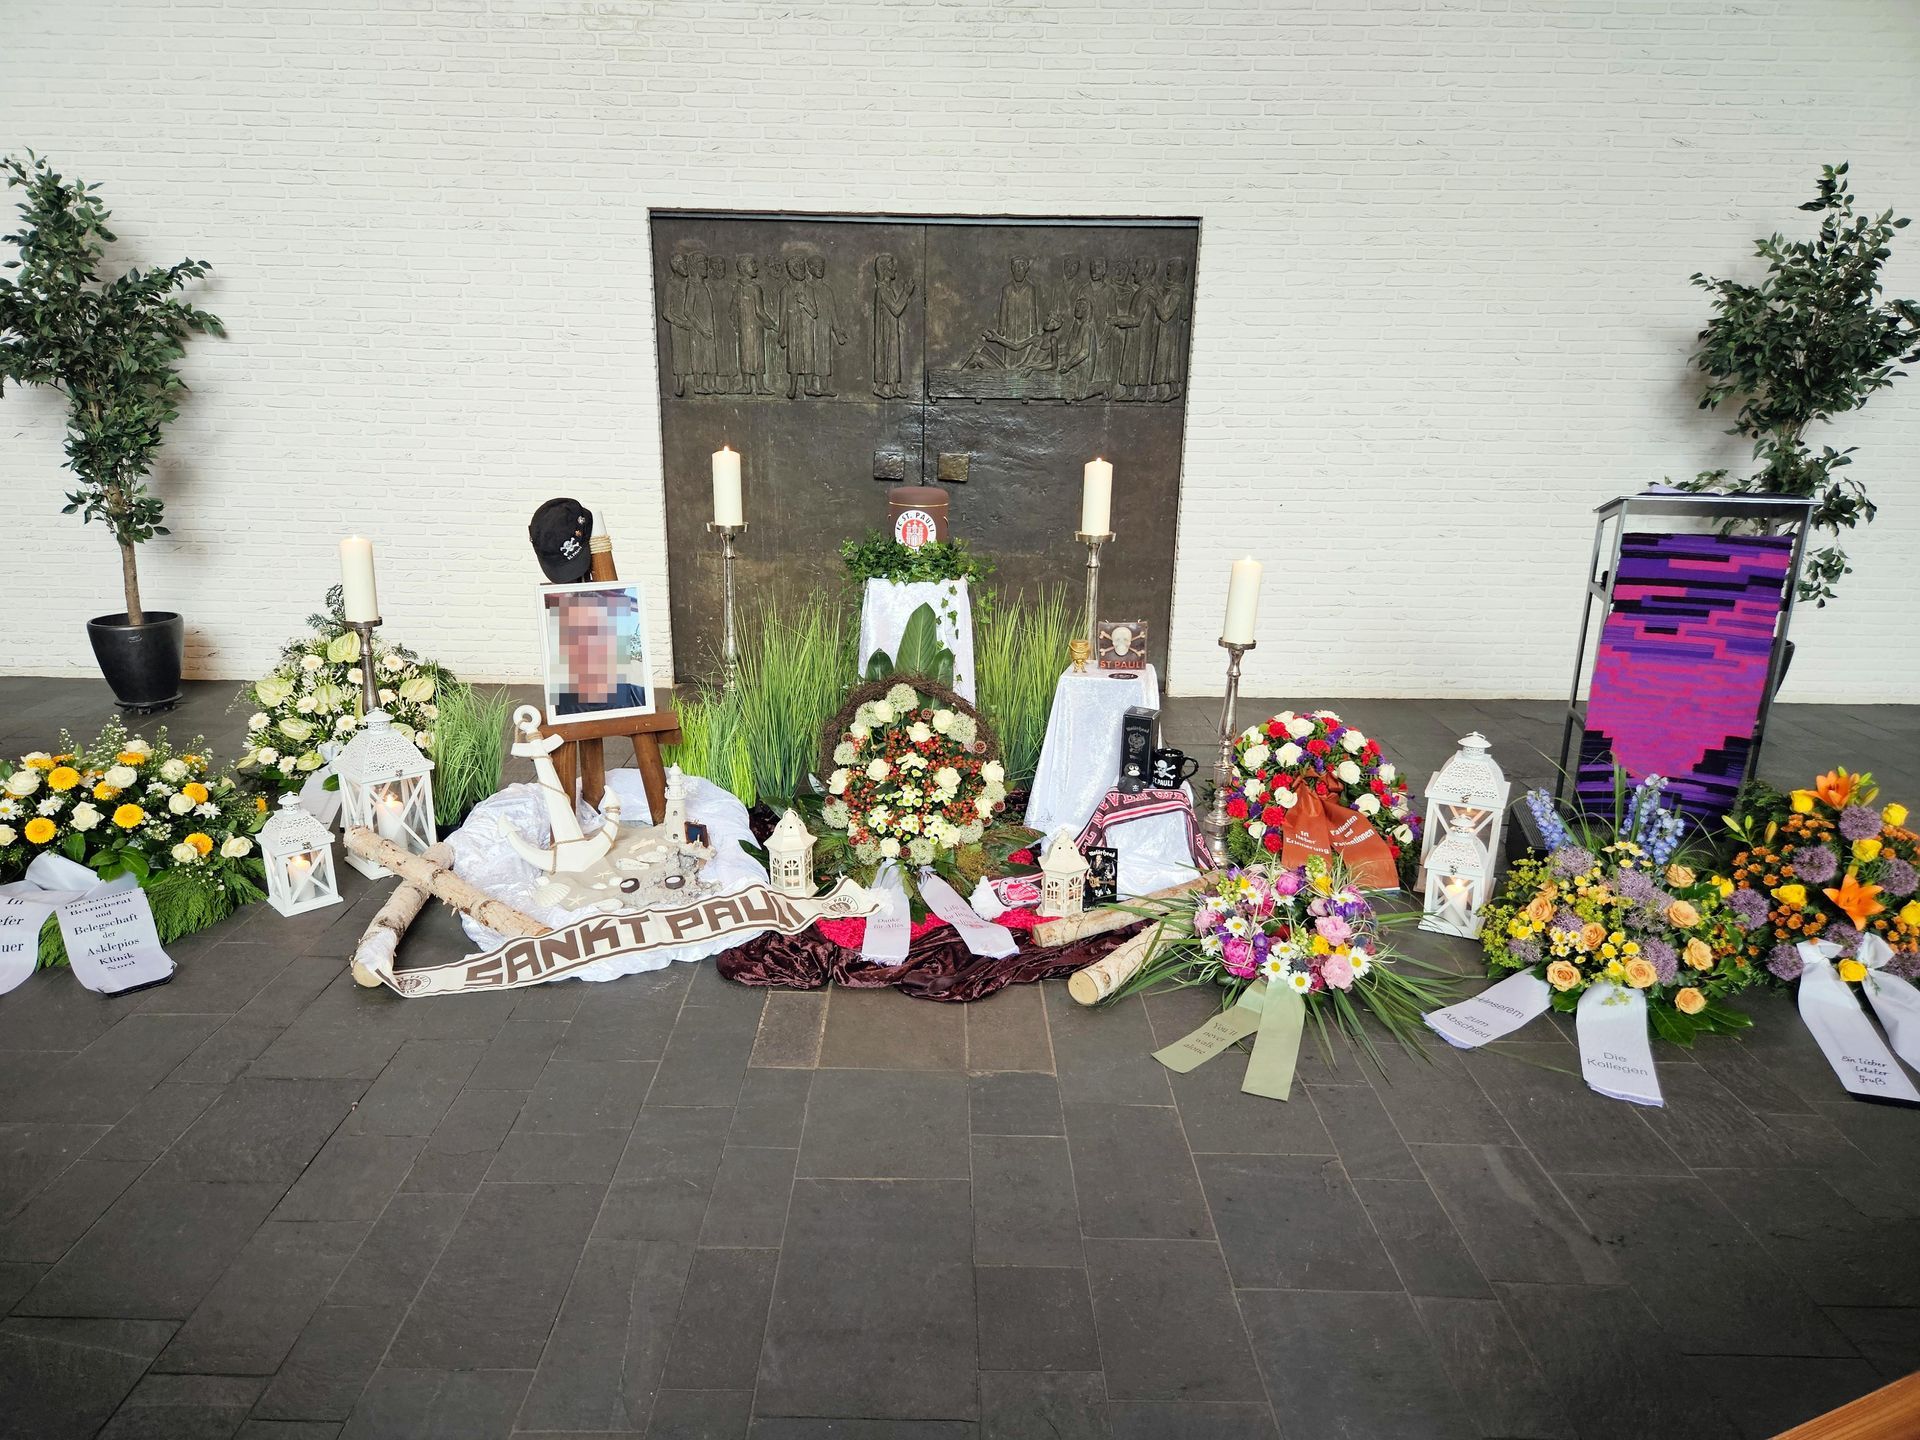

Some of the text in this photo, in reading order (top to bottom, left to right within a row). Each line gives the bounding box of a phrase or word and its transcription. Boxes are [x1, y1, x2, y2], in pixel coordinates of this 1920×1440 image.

[915, 511, 935, 532] PAULI
[1100, 660, 1145, 669] ST PAULI
[1330, 815, 1358, 836] Patienten
[95, 910, 112, 918] und
[74, 913, 138, 936] Belegschaft
[102, 931, 116, 939] der
[464, 889, 806, 987] SANKT PAULI
[87, 938, 140, 957] Asklepios
[99, 952, 135, 965] Klinik
[1441, 1012, 1492, 1040] Abschied
[1464, 1014, 1490, 1028] zum
[1183, 1043, 1207, 1055] alone
[1603, 1051, 1627, 1063] Die
[1586, 1058, 1649, 1076] Kollegen
